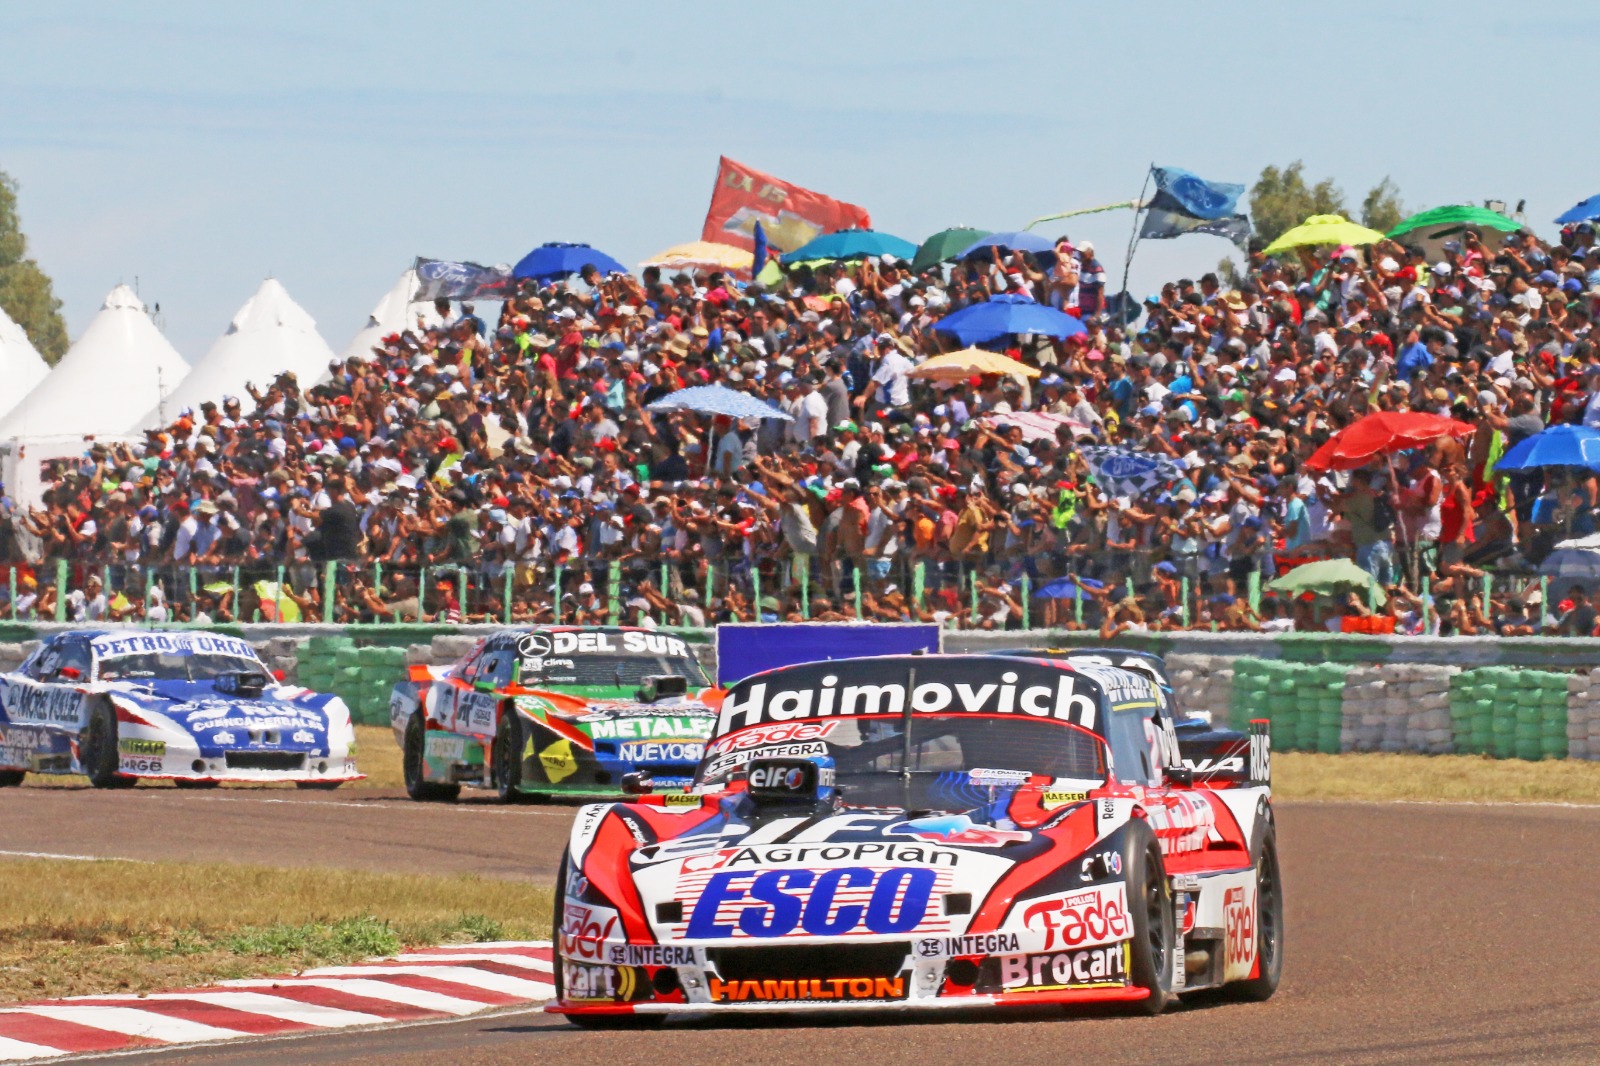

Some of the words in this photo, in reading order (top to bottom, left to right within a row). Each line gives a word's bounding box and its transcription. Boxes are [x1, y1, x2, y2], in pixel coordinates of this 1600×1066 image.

[92, 635, 172, 657] PETRO
[553, 632, 616, 654] DEL
[624, 632, 689, 658] SUR
[715, 672, 1096, 738] Haimovich
[717, 721, 840, 754] Fadel
[747, 744, 825, 761] INTEGRA
[749, 766, 788, 788] elf
[1045, 793, 1084, 801] KAESER
[684, 868, 937, 939] ESCO
[1067, 895, 1095, 907] POLLOS
[1023, 887, 1129, 951] Fadel
[945, 933, 1020, 955] INTEGRA
[629, 946, 696, 965] INTEGRA
[1001, 943, 1124, 988] Brocart
[710, 978, 904, 1001] HAMILTON
